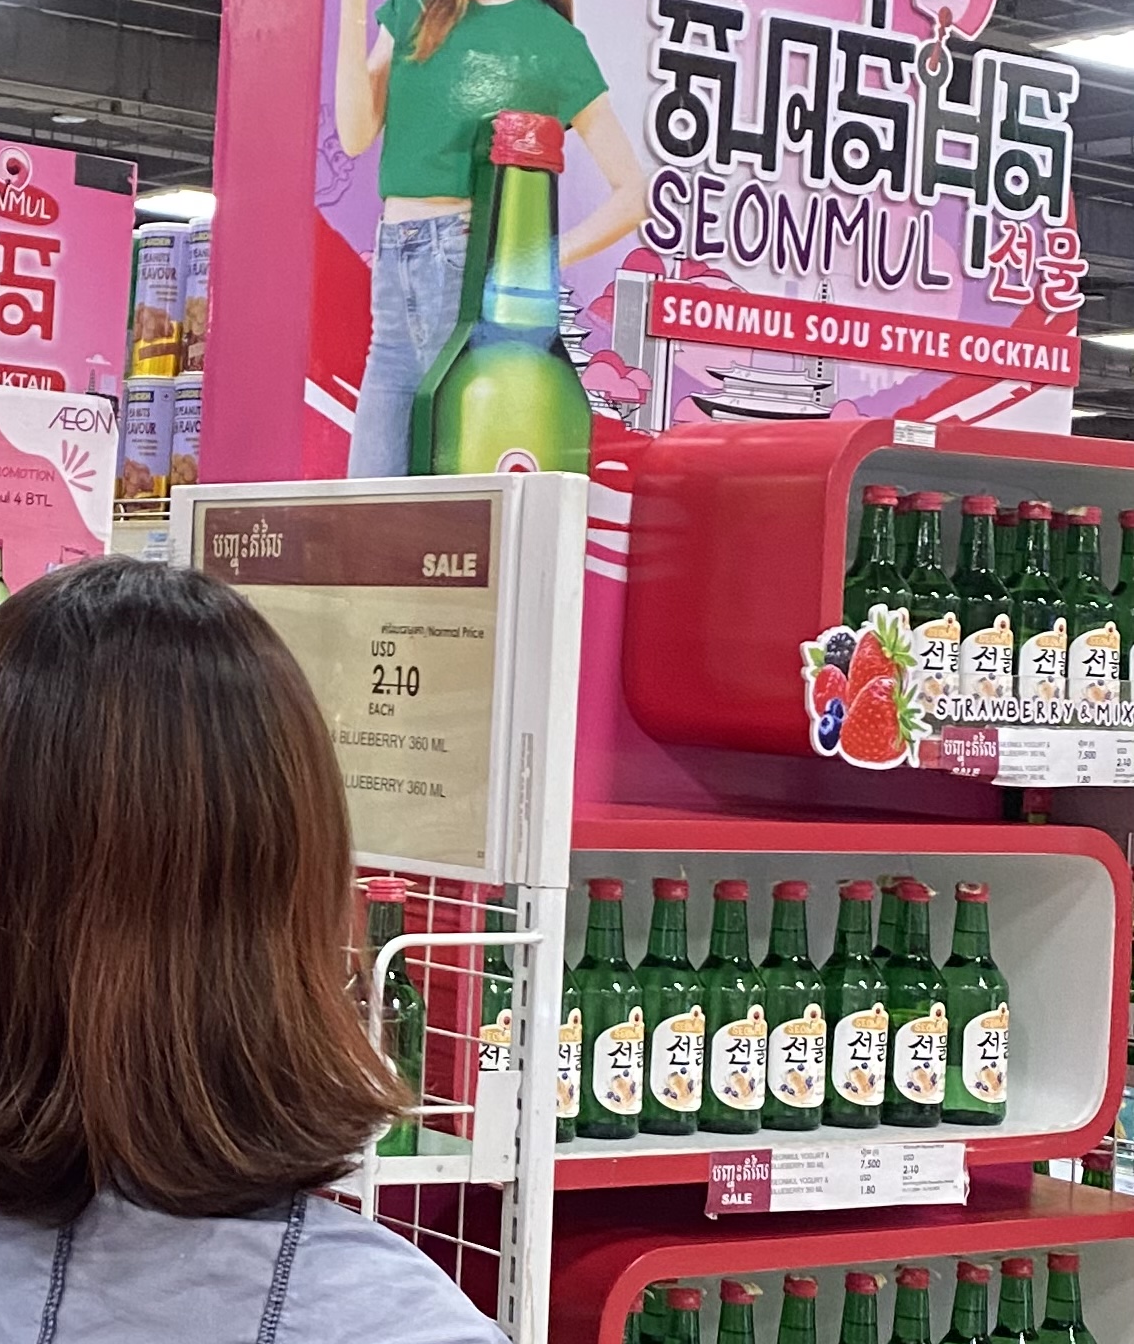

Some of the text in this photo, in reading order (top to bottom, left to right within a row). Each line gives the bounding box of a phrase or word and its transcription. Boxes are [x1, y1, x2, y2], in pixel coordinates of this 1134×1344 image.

[644, 169, 951, 288] SEONMUL
[662, 295, 1072, 374] SEONMUL SOJU STYLE COCKTAIL
[13, 493, 22, 505] 4
[26, 492, 53, 507] BTL
[422, 553, 477, 578] SALE
[371, 640, 396, 657] USD
[372, 664, 420, 697] 2.10
[368, 702, 395, 717] EACH
[936, 698, 1074, 722] STRAWBERRY
[1080, 706, 1091, 721] &
[339, 730, 449, 753] BLUEBERRY 360 ML
[344, 775, 446, 798] LUEBERRY 360 ML
[721, 1193, 752, 1205] SALE
[860, 1186, 875, 1194] 1.80
